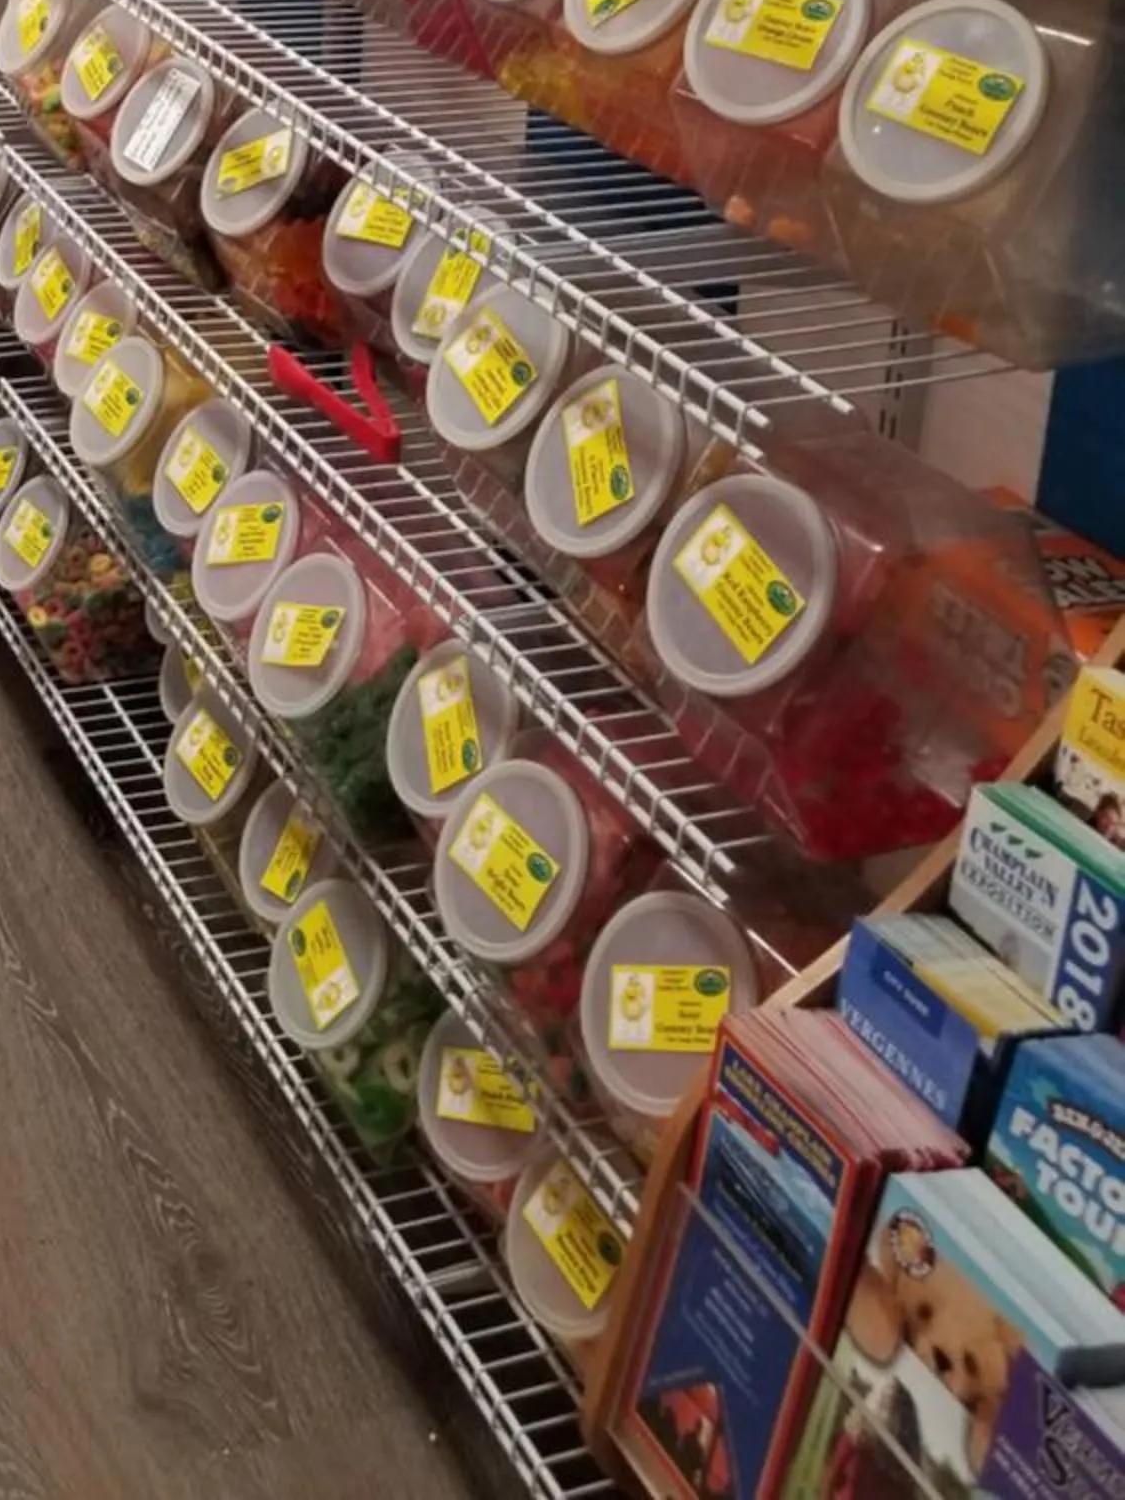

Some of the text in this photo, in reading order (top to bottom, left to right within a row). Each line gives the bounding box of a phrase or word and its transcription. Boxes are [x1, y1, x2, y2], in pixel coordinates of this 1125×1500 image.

[969, 826, 1061, 910] CHAMPLAIN
[983, 854, 1037, 903] VALLEY
[1057, 877, 1119, 1032] 2018
[842, 998, 948, 1111] VERGENNES
